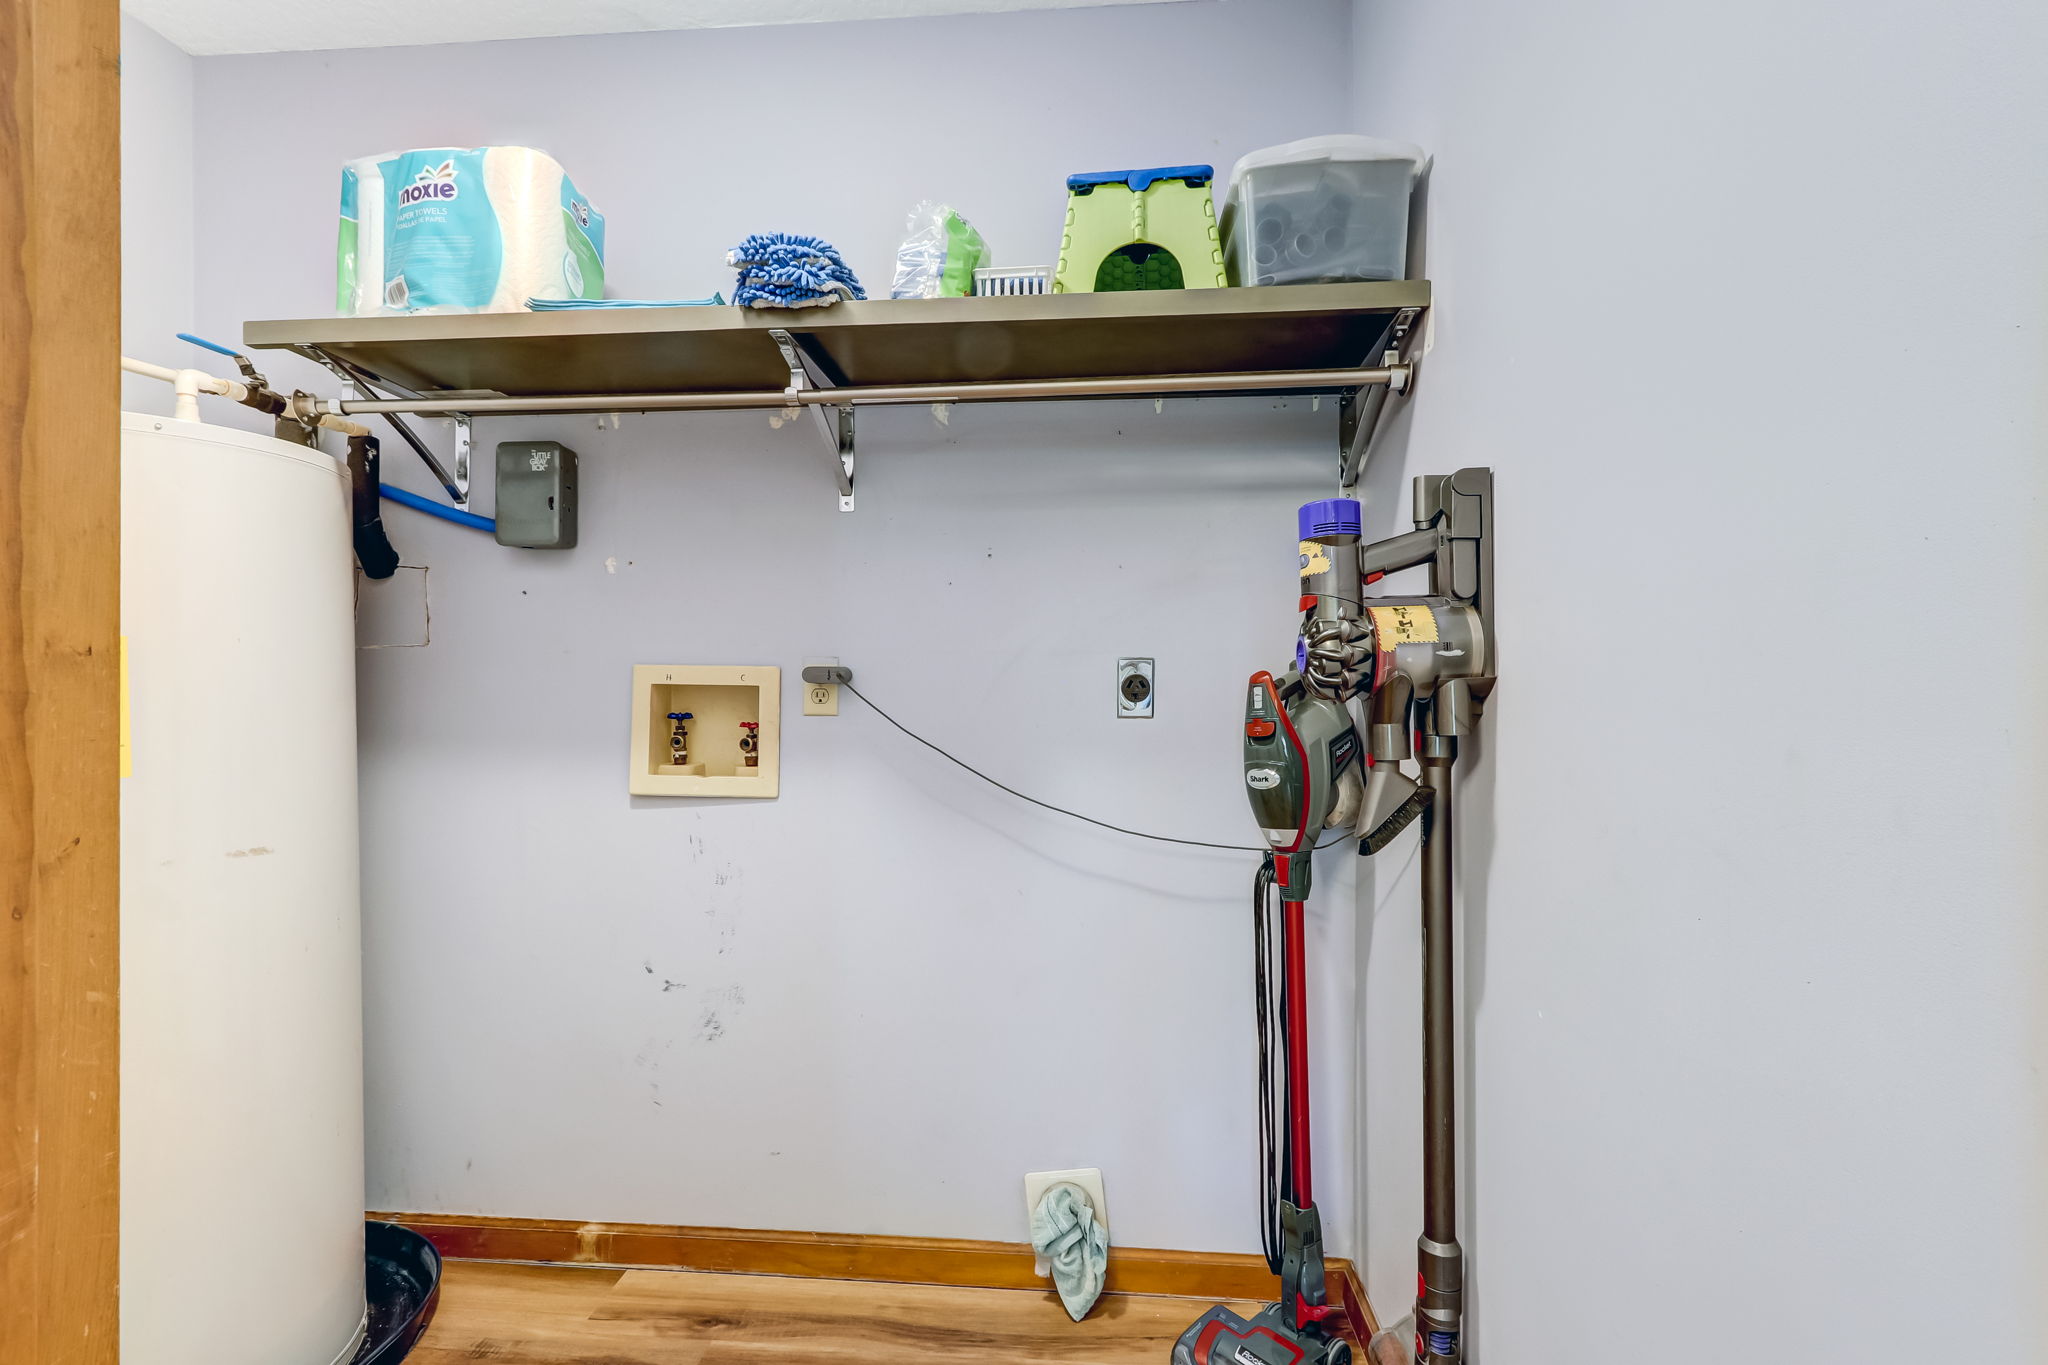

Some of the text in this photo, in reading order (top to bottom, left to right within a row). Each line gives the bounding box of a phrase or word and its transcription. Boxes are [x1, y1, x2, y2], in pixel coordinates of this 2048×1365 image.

[399, 183, 455, 206] moxie
[415, 207, 448, 217] TOWELS
[665, 673, 672, 681] H
[740, 673, 746, 681] C
[1250, 775, 1269, 783] Shark
